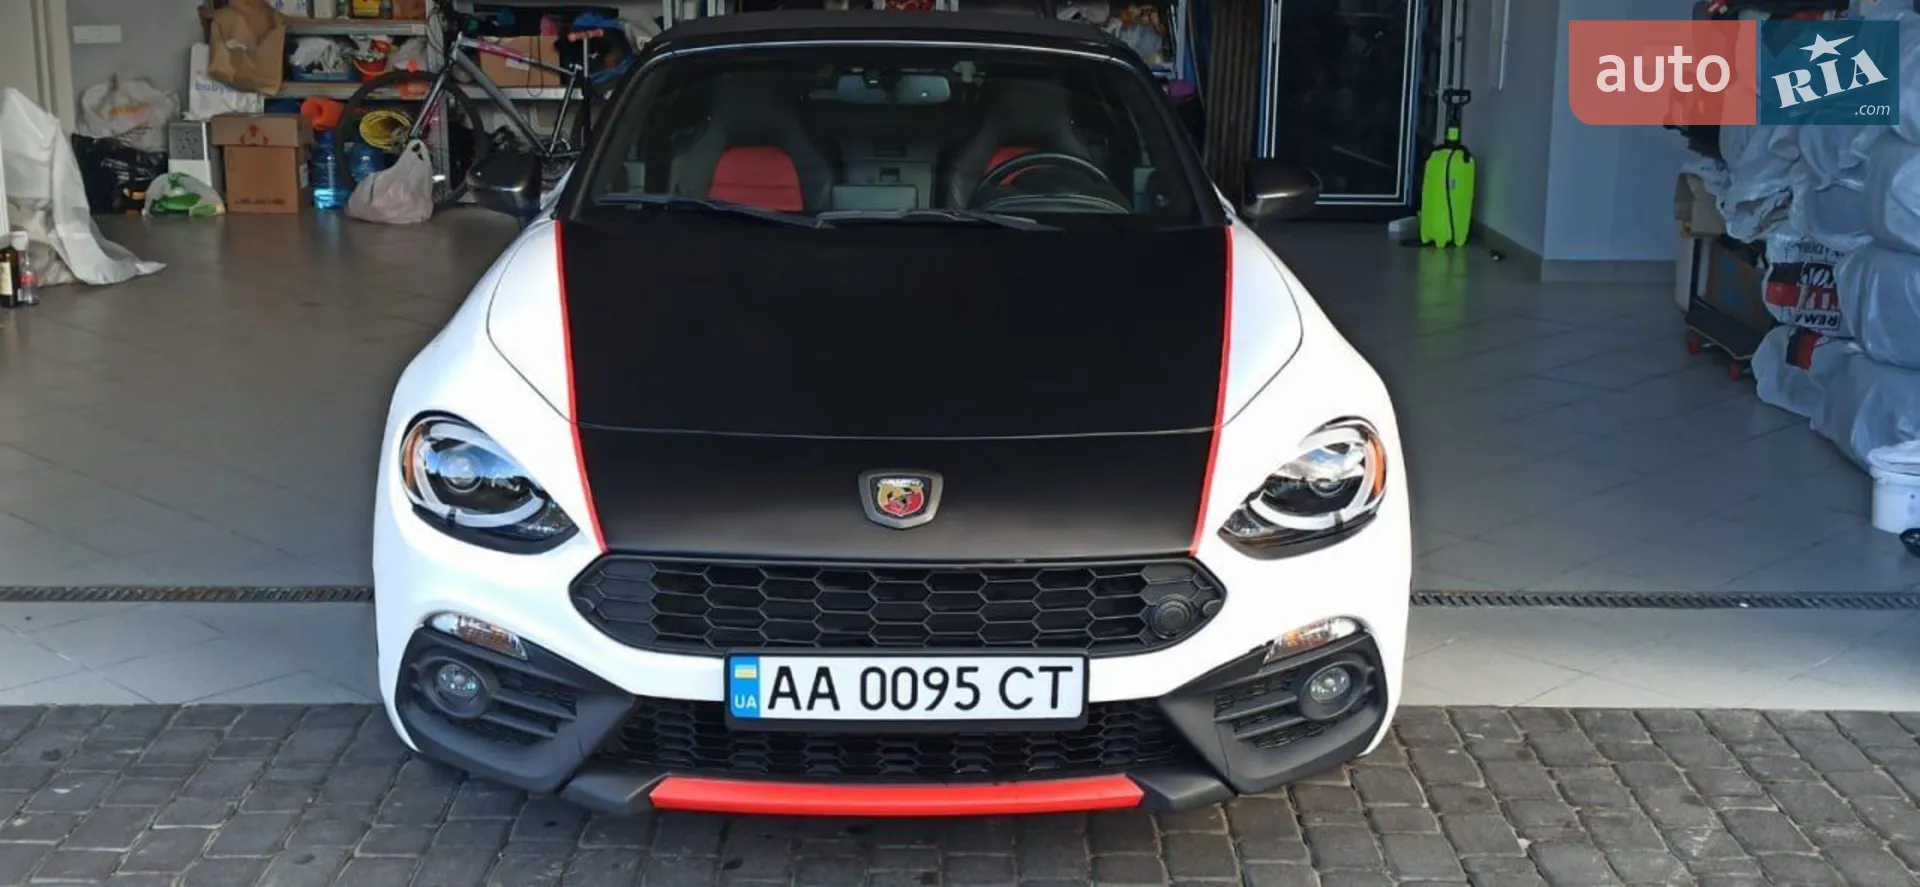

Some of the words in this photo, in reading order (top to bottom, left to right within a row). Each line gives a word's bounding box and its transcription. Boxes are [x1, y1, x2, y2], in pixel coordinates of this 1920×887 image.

[734, 695, 758, 709] UA
[767, 665, 841, 711] AA
[860, 666, 981, 711] 0095
[998, 665, 1074, 711] CT
